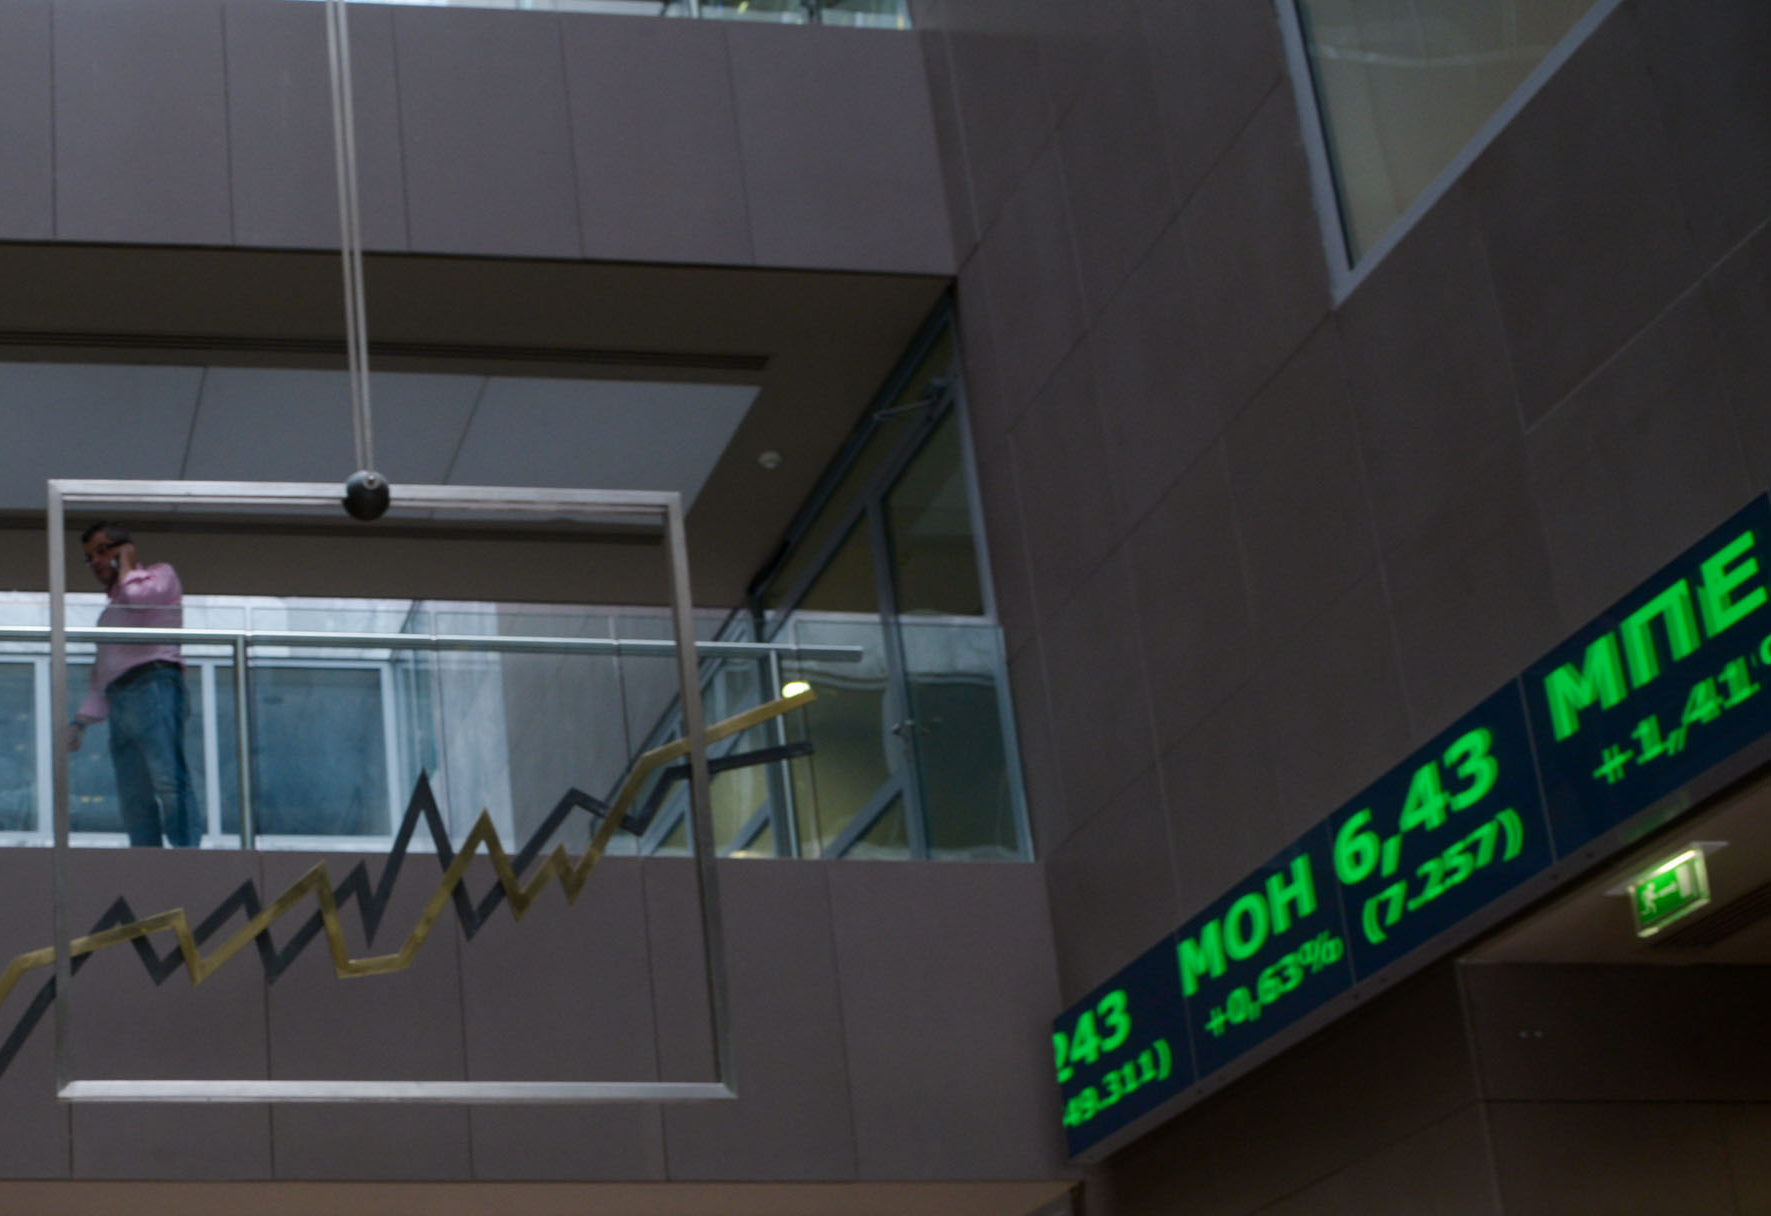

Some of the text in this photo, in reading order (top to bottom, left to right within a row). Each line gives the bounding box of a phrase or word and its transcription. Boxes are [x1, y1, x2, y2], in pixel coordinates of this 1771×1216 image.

[1177, 852, 1318, 998] ΜΟΗ
[1333, 726, 1499, 885] 6,43
[1204, 930, 1344, 1037] +0,63%
[1362, 807, 1525, 944] (7.257)
